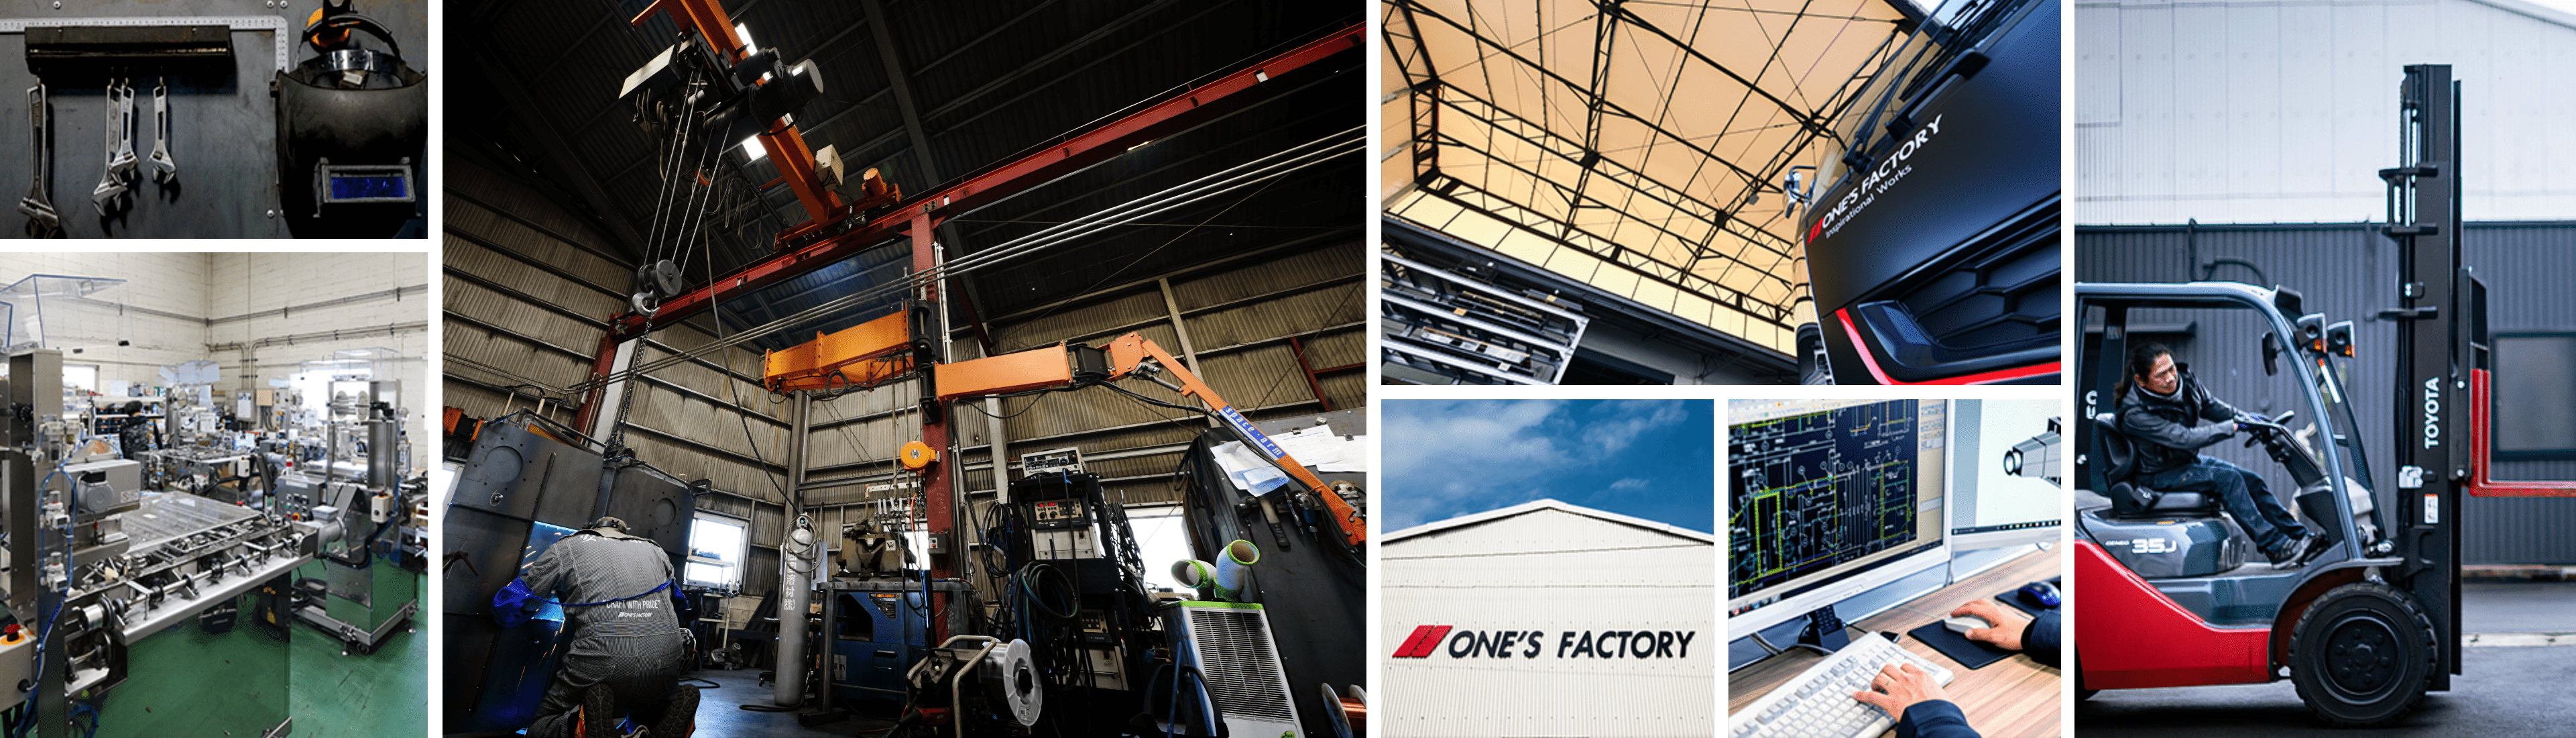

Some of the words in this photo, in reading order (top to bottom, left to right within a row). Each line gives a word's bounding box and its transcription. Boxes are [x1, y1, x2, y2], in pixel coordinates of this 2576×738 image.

[1822, 188, 1859, 229] ONE'S
[1861, 113, 1942, 195] FACTORY
[1825, 193, 1875, 239] Inspirational
[1876, 164, 1912, 195] Works
[2424, 376, 2440, 450] TOYOTA
[2131, 537, 2177, 554] 35J
[627, 600, 642, 609] WITH
[1448, 629, 1544, 659] ONE'S
[1557, 629, 1696, 659] FACTORY
